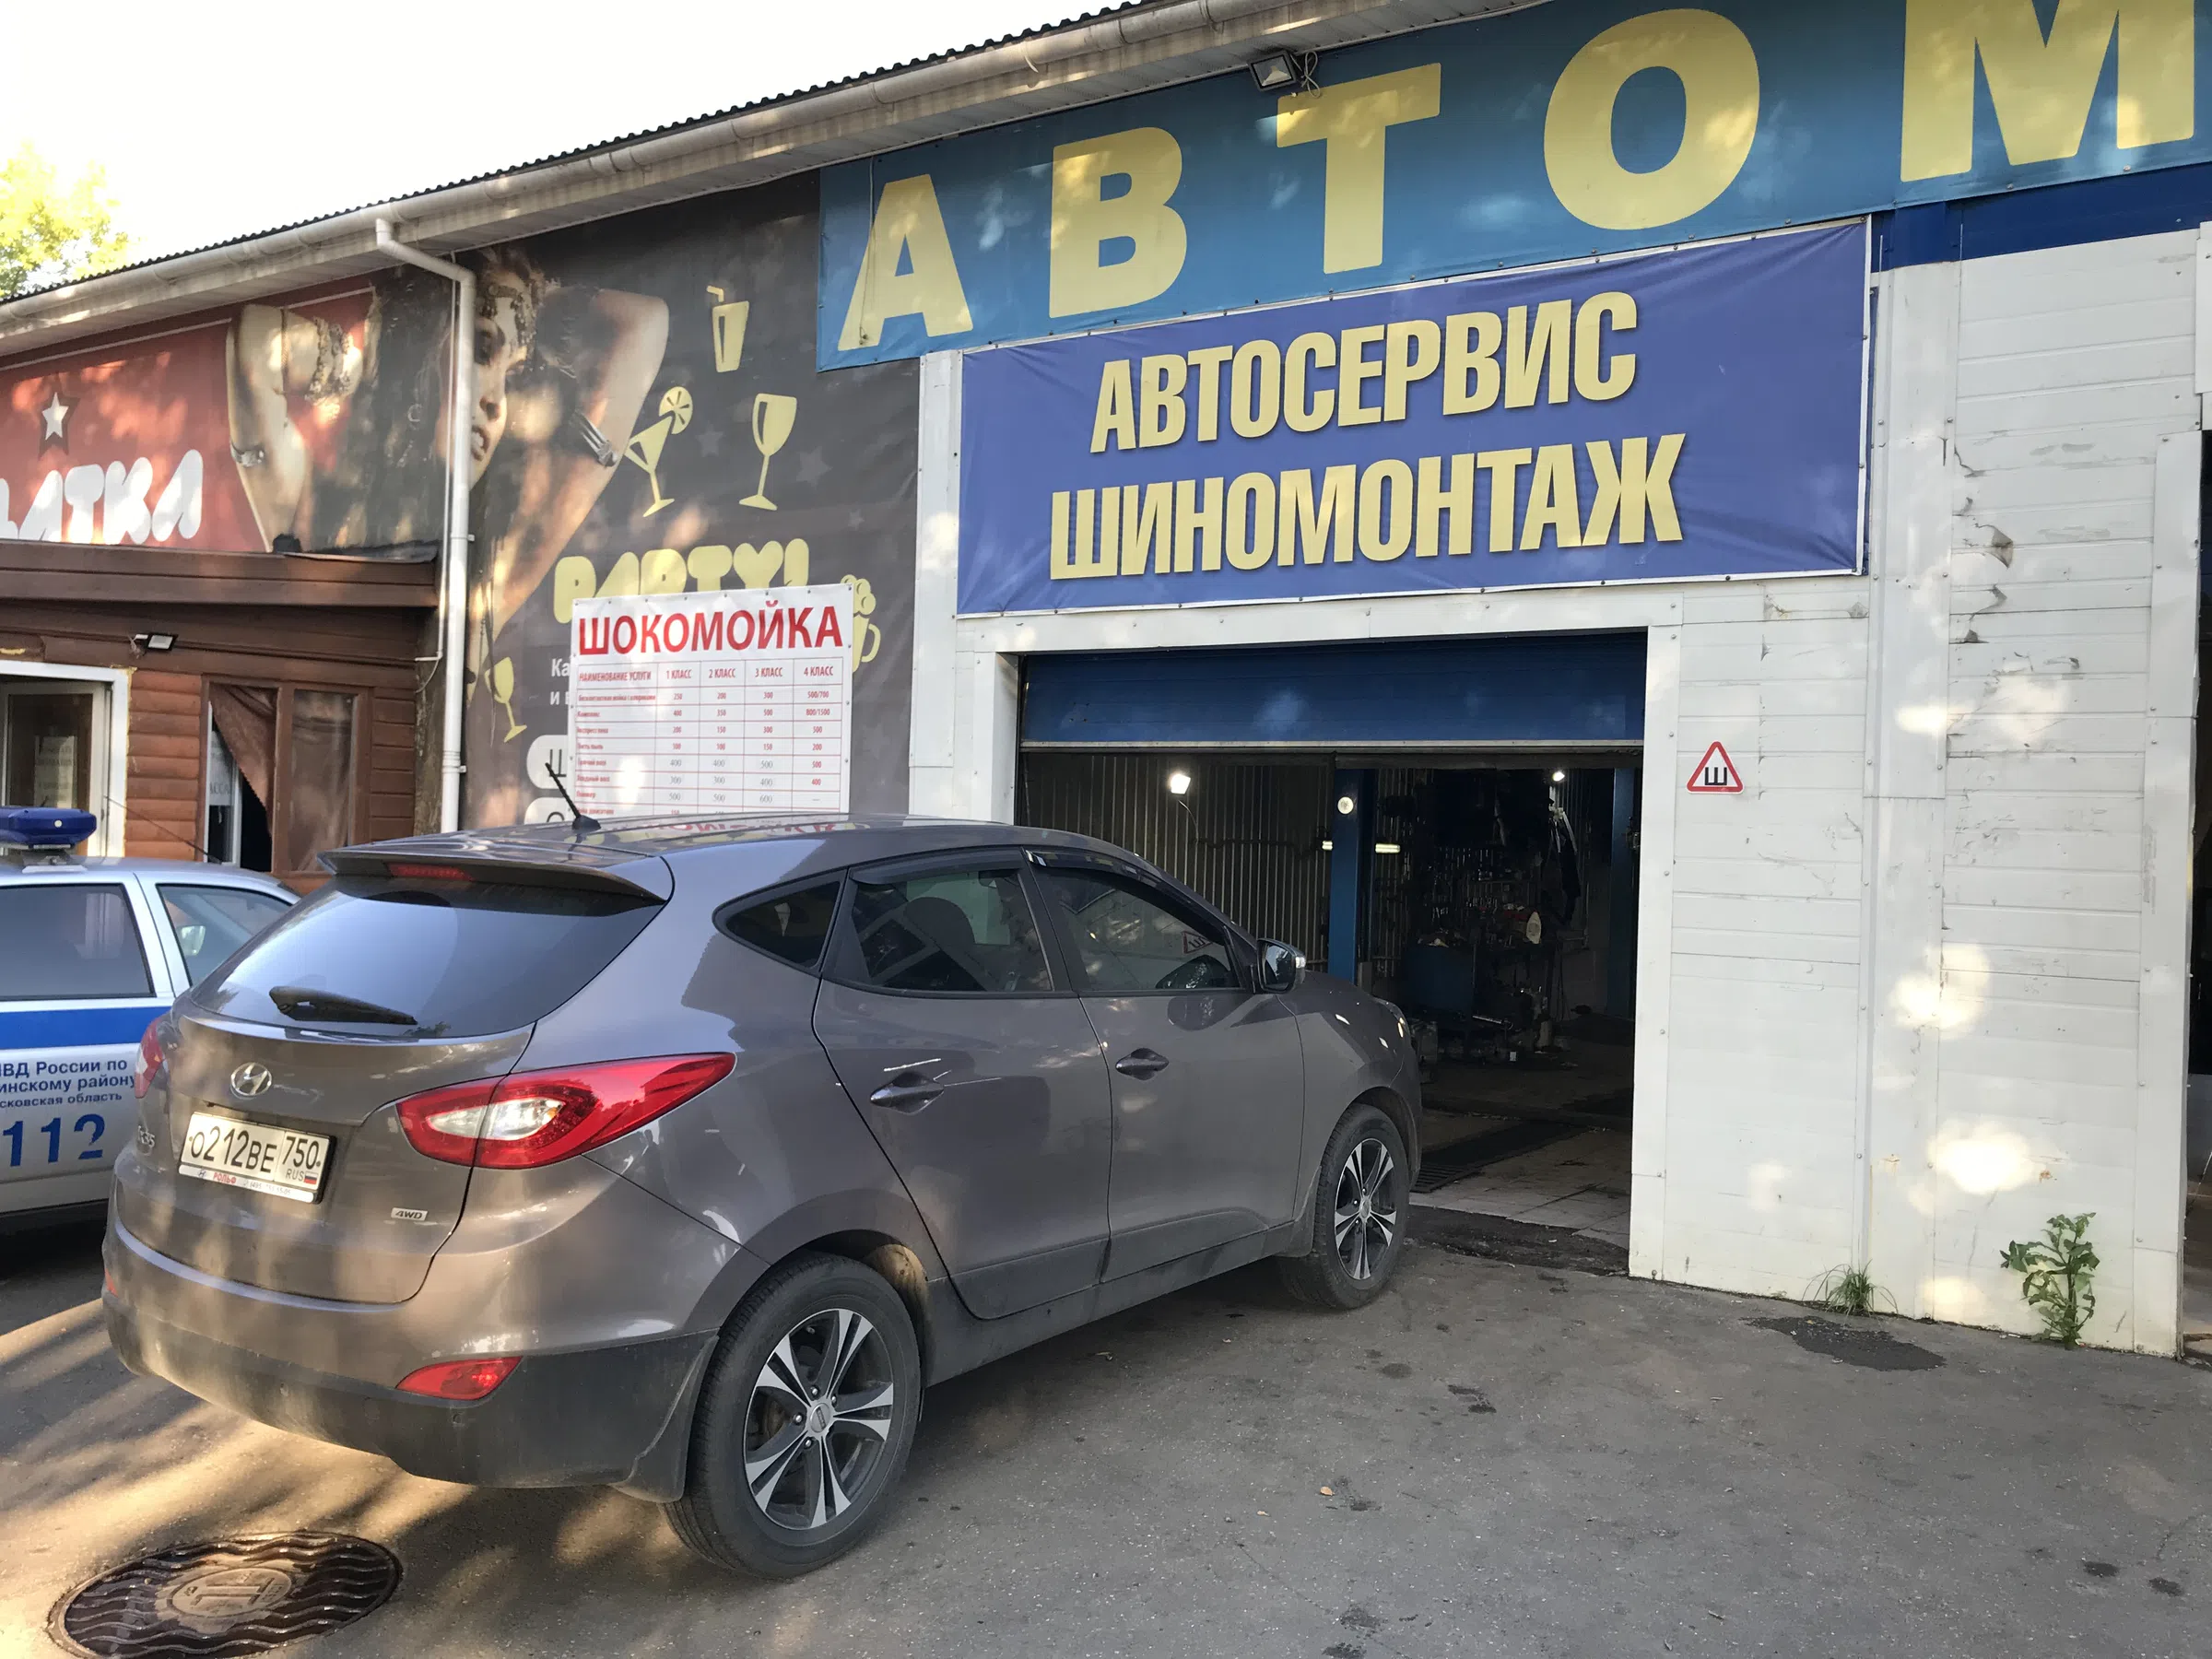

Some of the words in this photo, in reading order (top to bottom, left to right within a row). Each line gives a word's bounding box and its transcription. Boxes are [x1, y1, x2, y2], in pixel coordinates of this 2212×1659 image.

[1090, 291, 1638, 453] АВТОСЕРВИС
[1050, 433, 1686, 581] ШИНОМОНТАЖ
[579, 600, 843, 655] ШОКОМОЙКА
[671, 669, 692, 679] КЛАСС
[709, 669, 713, 678] 2
[714, 668, 735, 678] КЛАСС
[755, 668, 759, 677] 3
[760, 667, 782, 677] КЛАСС
[804, 667, 808, 677] 4
[810, 665, 833, 676] КЛАСС
[807, 690, 830, 699] 500/700
[812, 743, 823, 751] 200
[759, 778, 773, 786] 400
[759, 794, 772, 804] 600
[36, 1061, 100, 1075] России
[107, 1060, 127, 1070] по
[77, 1075, 135, 1092] району
[67, 1093, 123, 1104] область
[3, 1113, 105, 1167] 112
[282, 1135, 320, 1170] 750
[285, 1169, 304, 1182] RUS
[395, 1210, 423, 1219] 4WD
